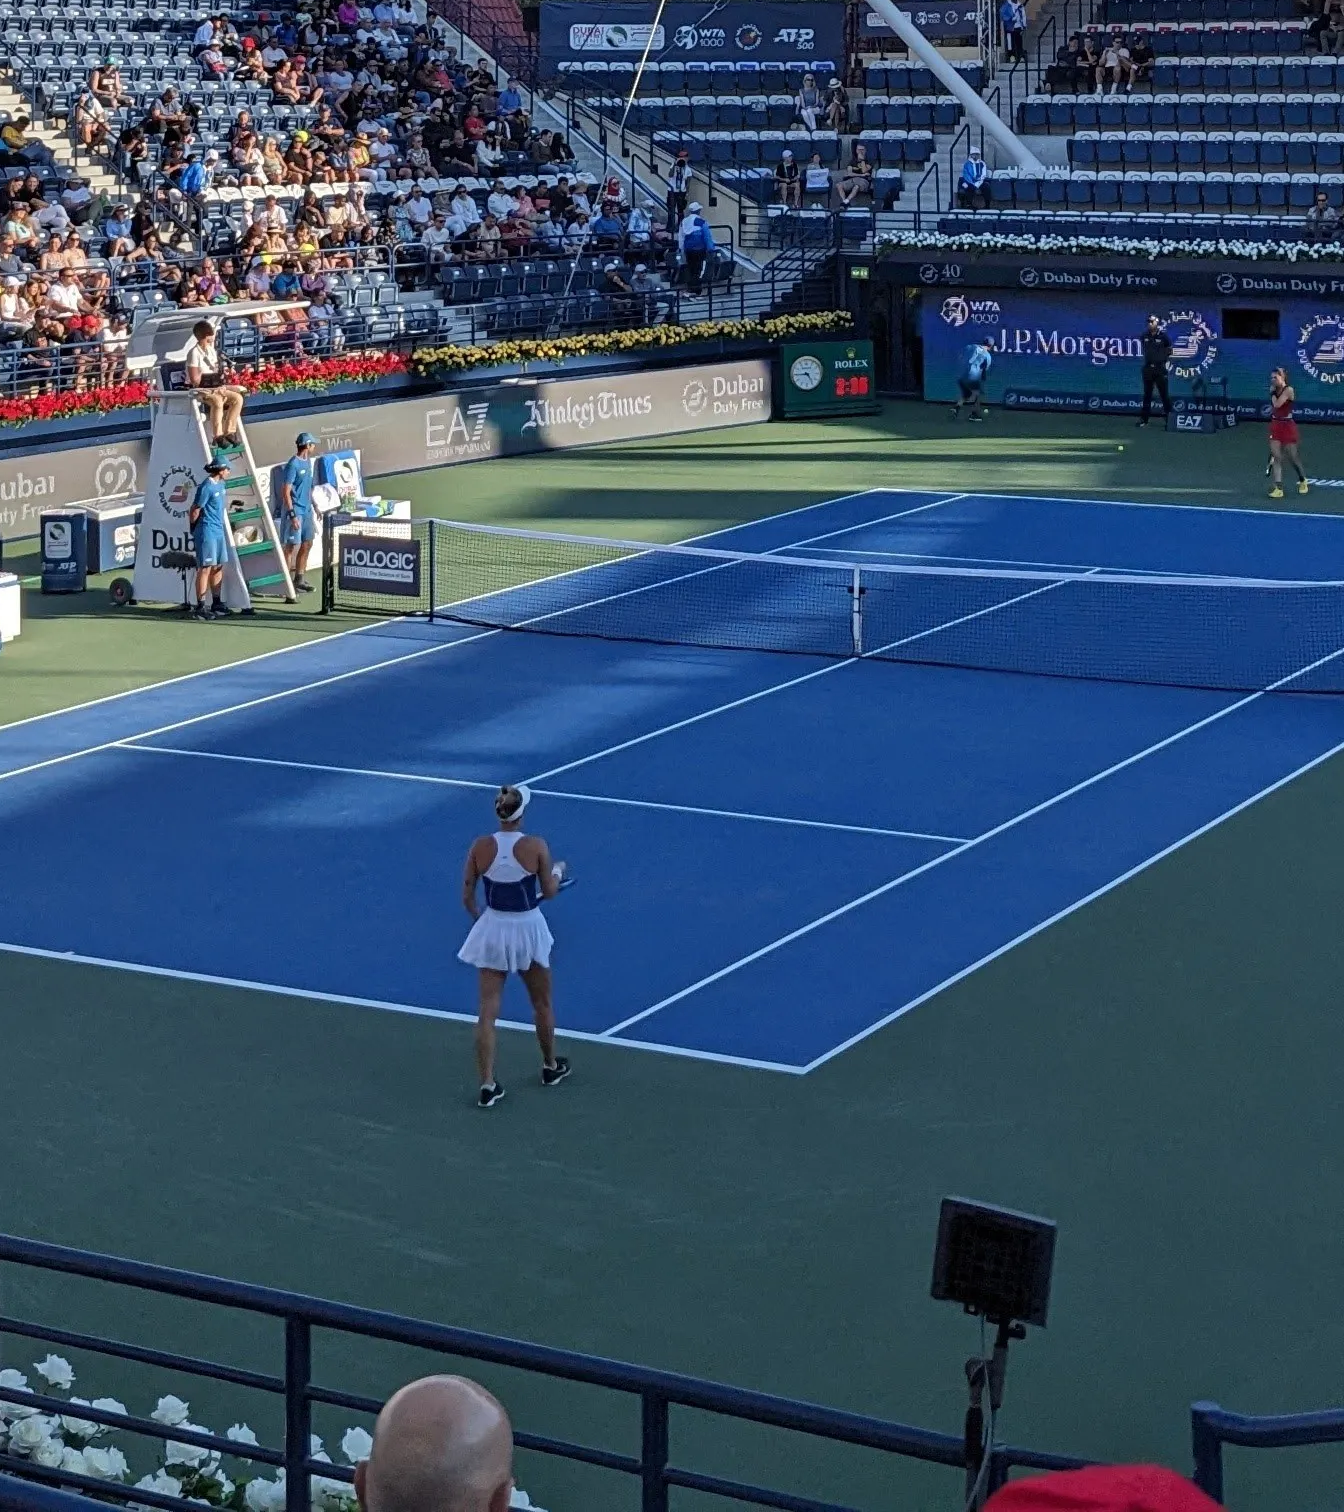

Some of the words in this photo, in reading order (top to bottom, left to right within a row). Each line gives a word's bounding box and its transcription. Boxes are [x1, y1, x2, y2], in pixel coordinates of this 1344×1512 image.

[699, 29, 726, 38] WTA
[773, 29, 814, 43] ATP
[700, 38, 724, 47] 1000
[797, 42, 814, 50] 500
[941, 264, 961, 278] 40
[1044, 272, 1086, 285] Dubai
[1089, 273, 1123, 287] Duty
[1126, 274, 1157, 286] Free
[1241, 277, 1287, 290] Dubai
[1291, 279, 1328, 294] Duty
[970, 301, 1000, 312] WTA
[971, 313, 999, 324] 1000
[994, 329, 1144, 365] J.P.Morgan
[834, 359, 869, 369] ROLEX
[1297, 348, 1318, 378] DUBAI
[1175, 366, 1203, 377] DUTY
[712, 374, 764, 397] Dubai
[521, 396, 594, 436] Khaleej
[597, 391, 653, 418] Times
[713, 399, 739, 415] Duty
[740, 397, 764, 411] Free
[426, 402, 490, 447] EA7
[1177, 414, 1203, 428] EA7
[327, 437, 353, 452] Win
[159, 491, 173, 513] DUBAI
[152, 529, 196, 552] Dub
[343, 547, 414, 570] HOLOGIC
